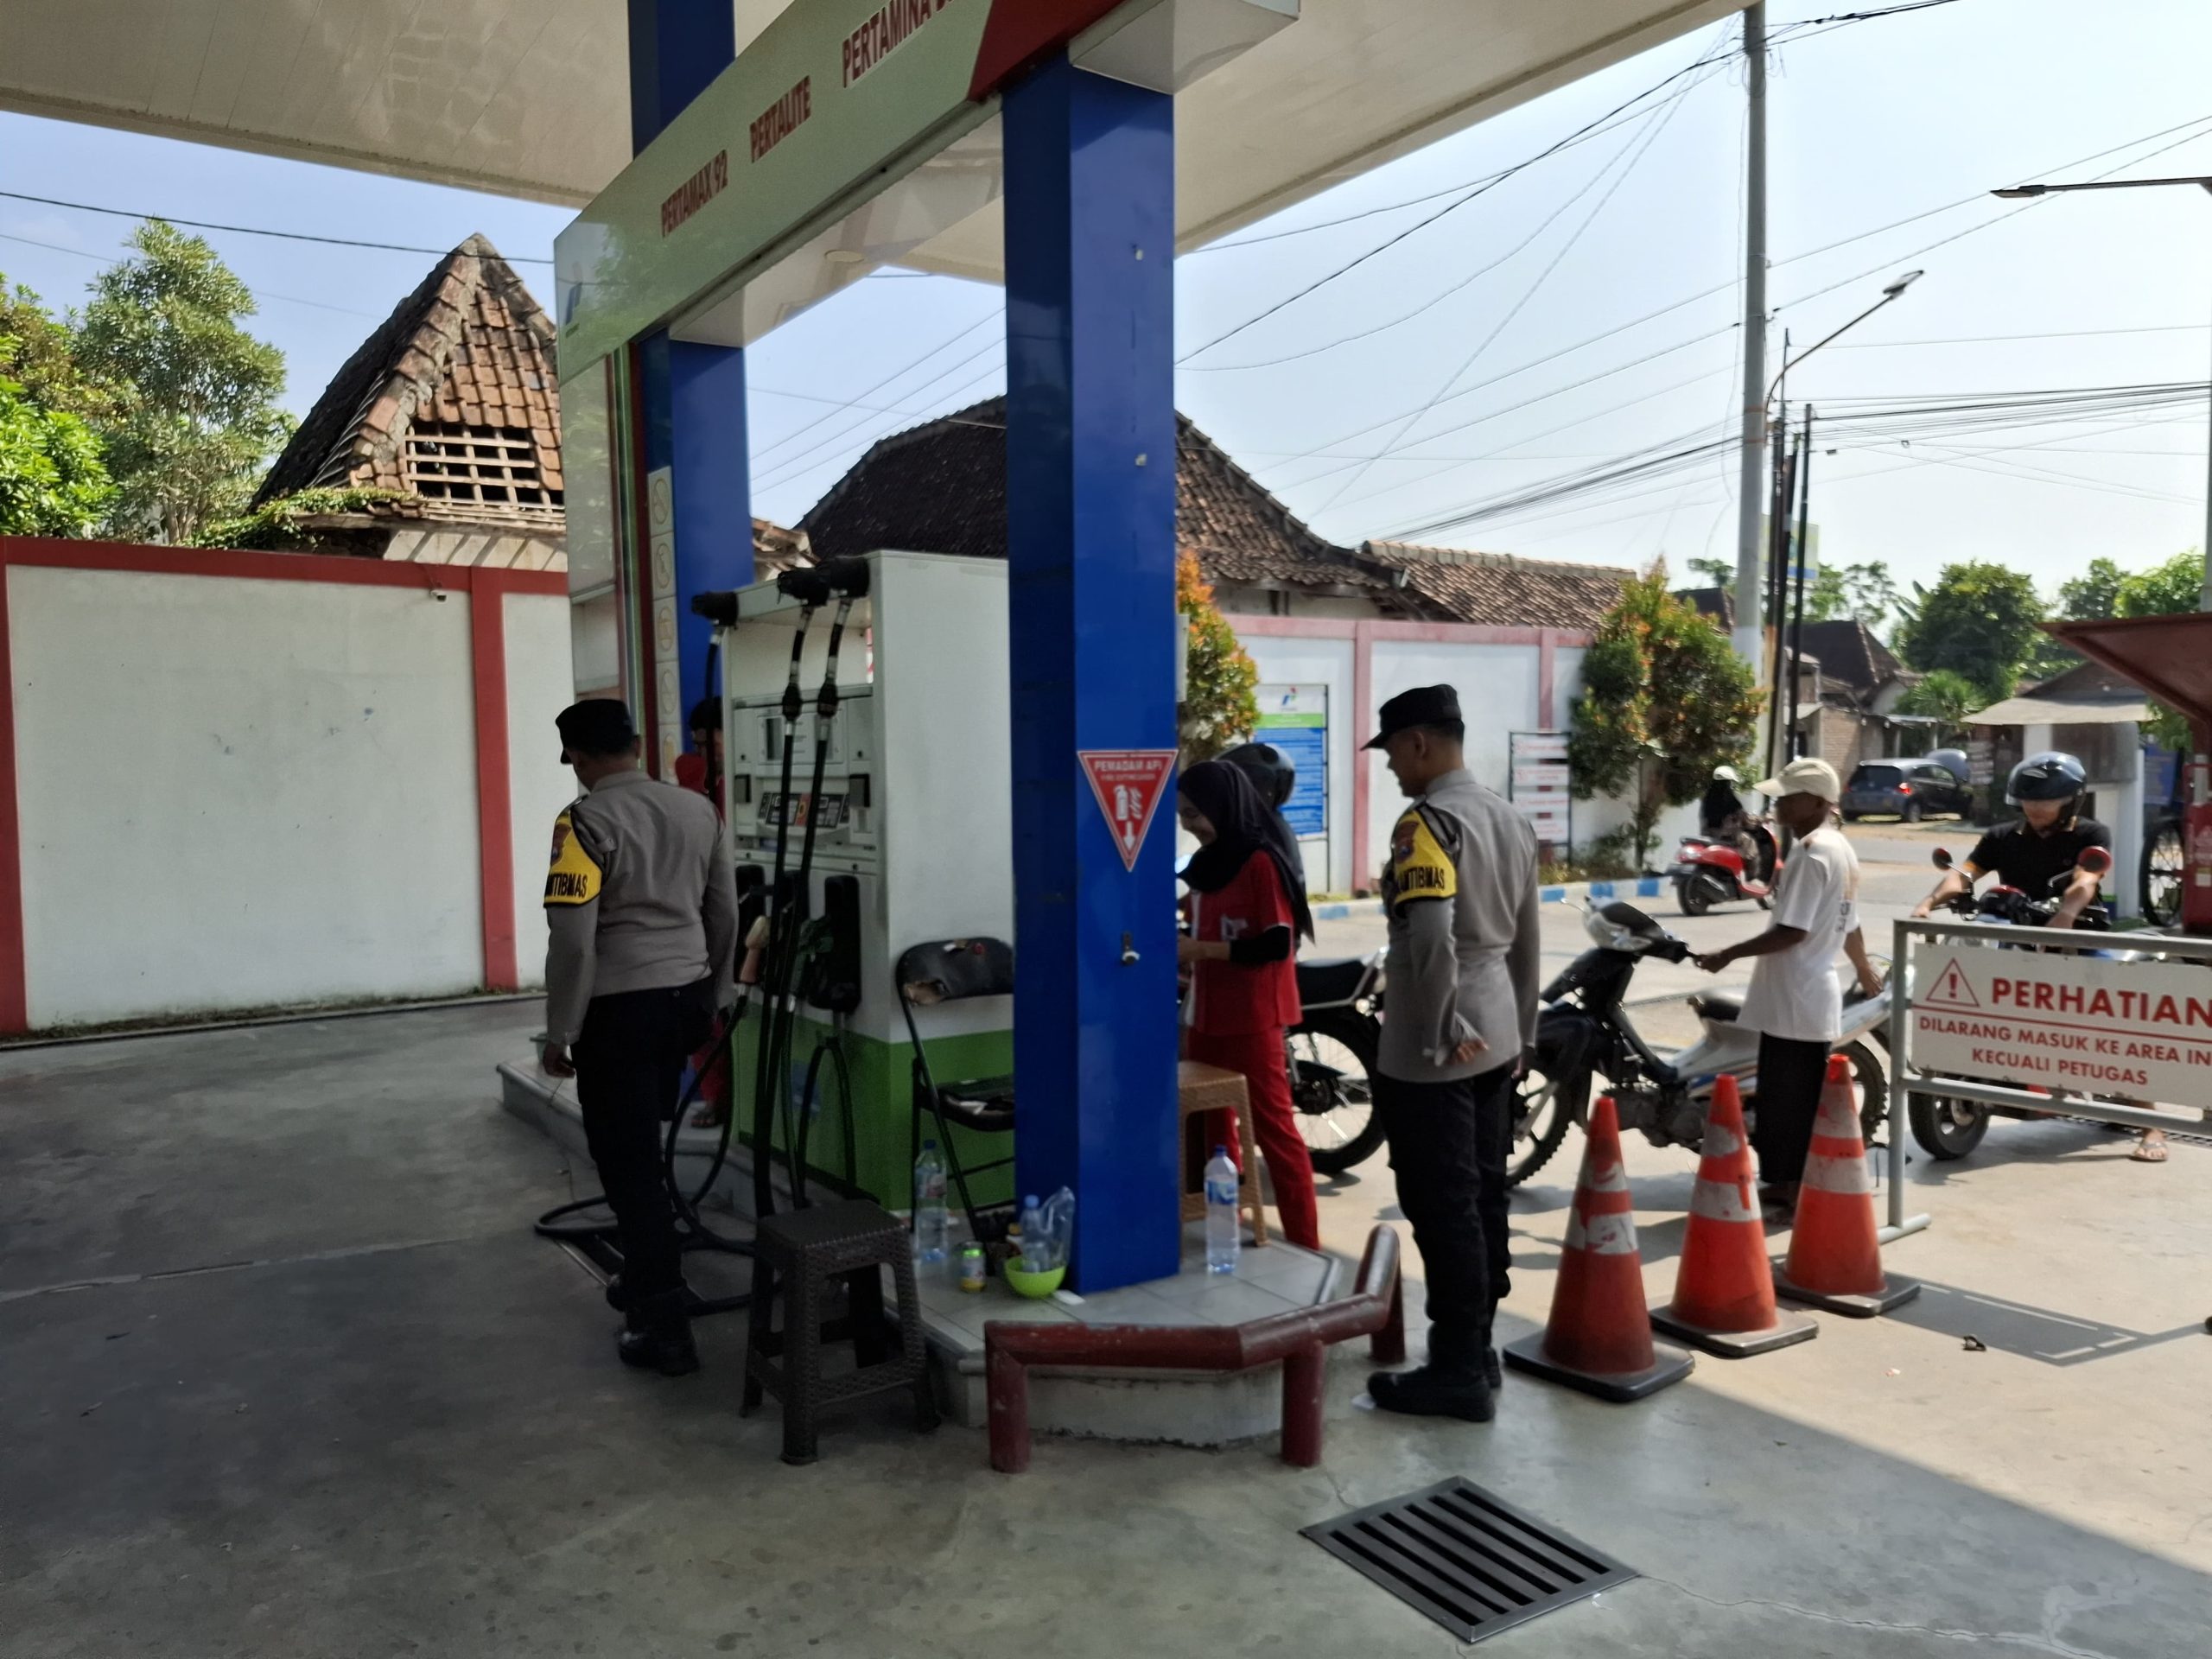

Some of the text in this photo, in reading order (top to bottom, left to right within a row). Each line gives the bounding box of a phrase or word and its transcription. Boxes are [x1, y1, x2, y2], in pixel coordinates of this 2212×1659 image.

[750, 74, 811, 164] PERTALITE
[661, 149, 728, 238] PERTAMAX 92
[1147, 760, 1162, 770] API
[1992, 977, 2212, 1028] PERHATIAN
[1919, 1016, 2012, 1041] DILARANG
[2018, 1029, 2088, 1052] MASUK
[2095, 1039, 2120, 1055] KE
[2125, 1042, 2180, 1063] AREA
[1972, 1047, 2148, 1085] KECUALI PETUGAS
